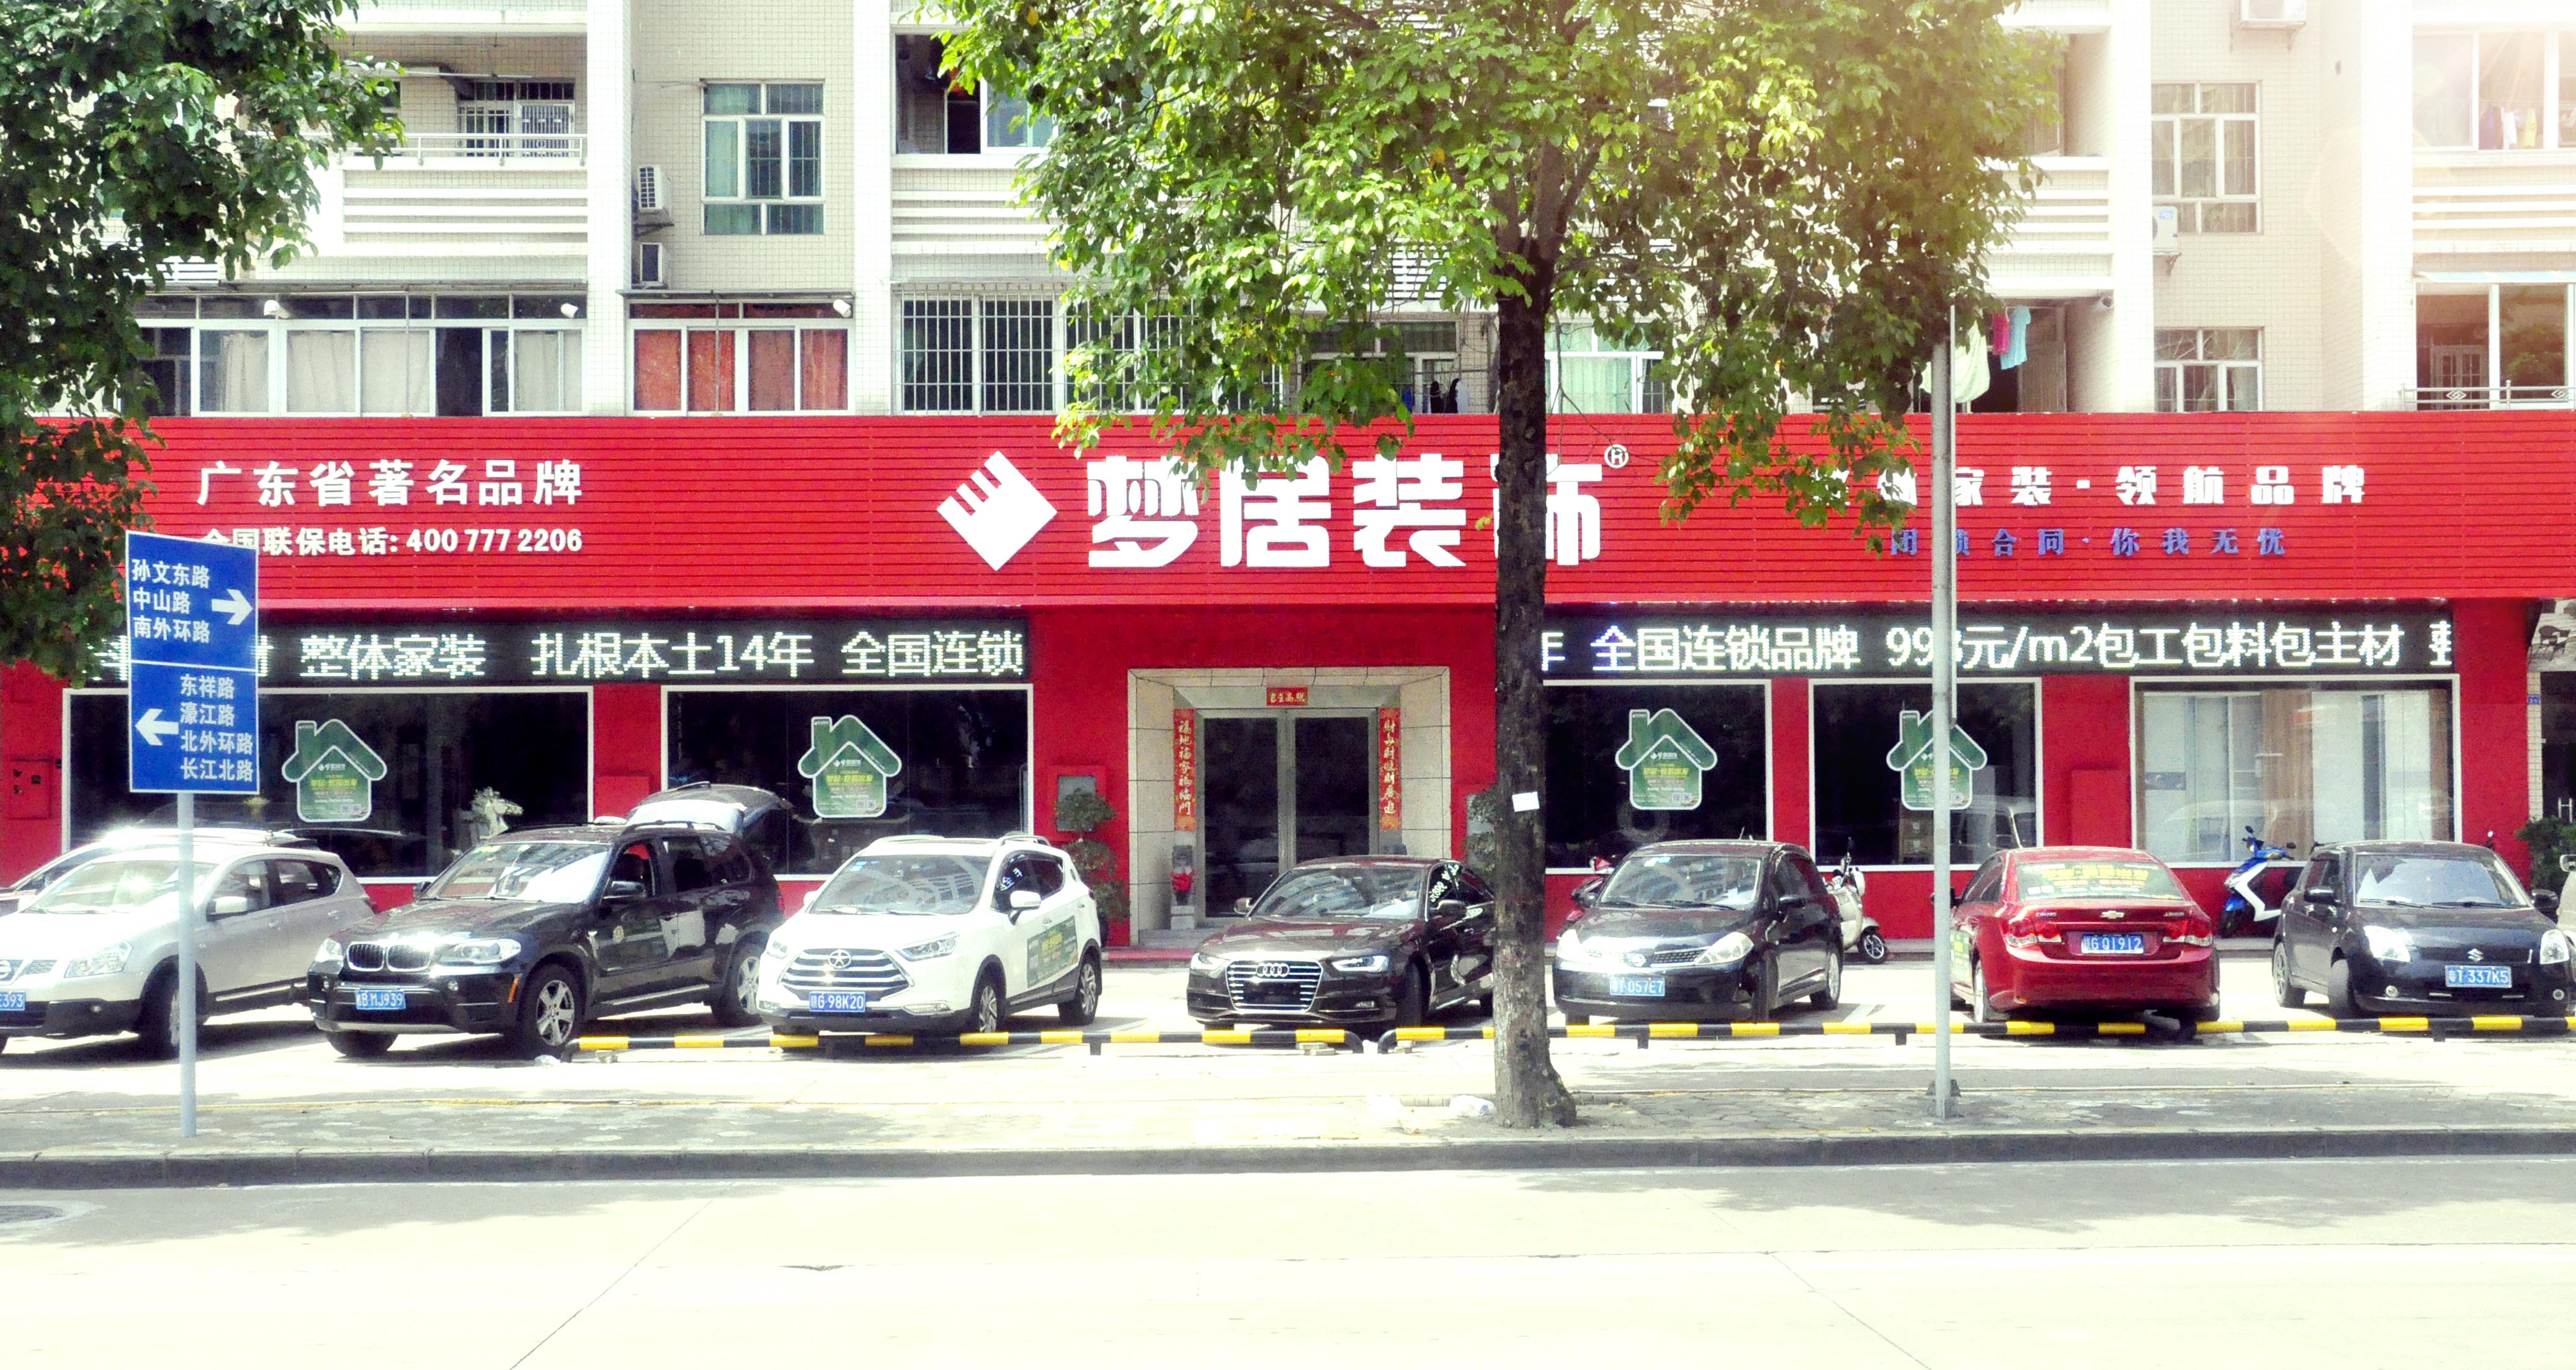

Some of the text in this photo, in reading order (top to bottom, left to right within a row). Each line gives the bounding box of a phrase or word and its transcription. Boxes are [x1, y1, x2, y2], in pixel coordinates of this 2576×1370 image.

[197, 459, 582, 507] 广东省著名品牌
[406, 529, 458, 552] 400
[465, 529, 511, 552] 777
[517, 529, 582, 552] 2206
[132, 559, 210, 588] 孙文东路
[133, 586, 190, 614] 中山路
[133, 615, 210, 643] 南外环路
[299, 633, 486, 681] 整体家装
[530, 632, 815, 679] 扎根本土14年
[841, 630, 1024, 677] 全国连锁
[1590, 624, 1861, 671] 全国连锁品牌
[180, 673, 235, 699] 东祥路
[180, 702, 235, 727] 濠江路
[181, 730, 253, 754] 北外环路
[180, 757, 253, 782] 长江北路
